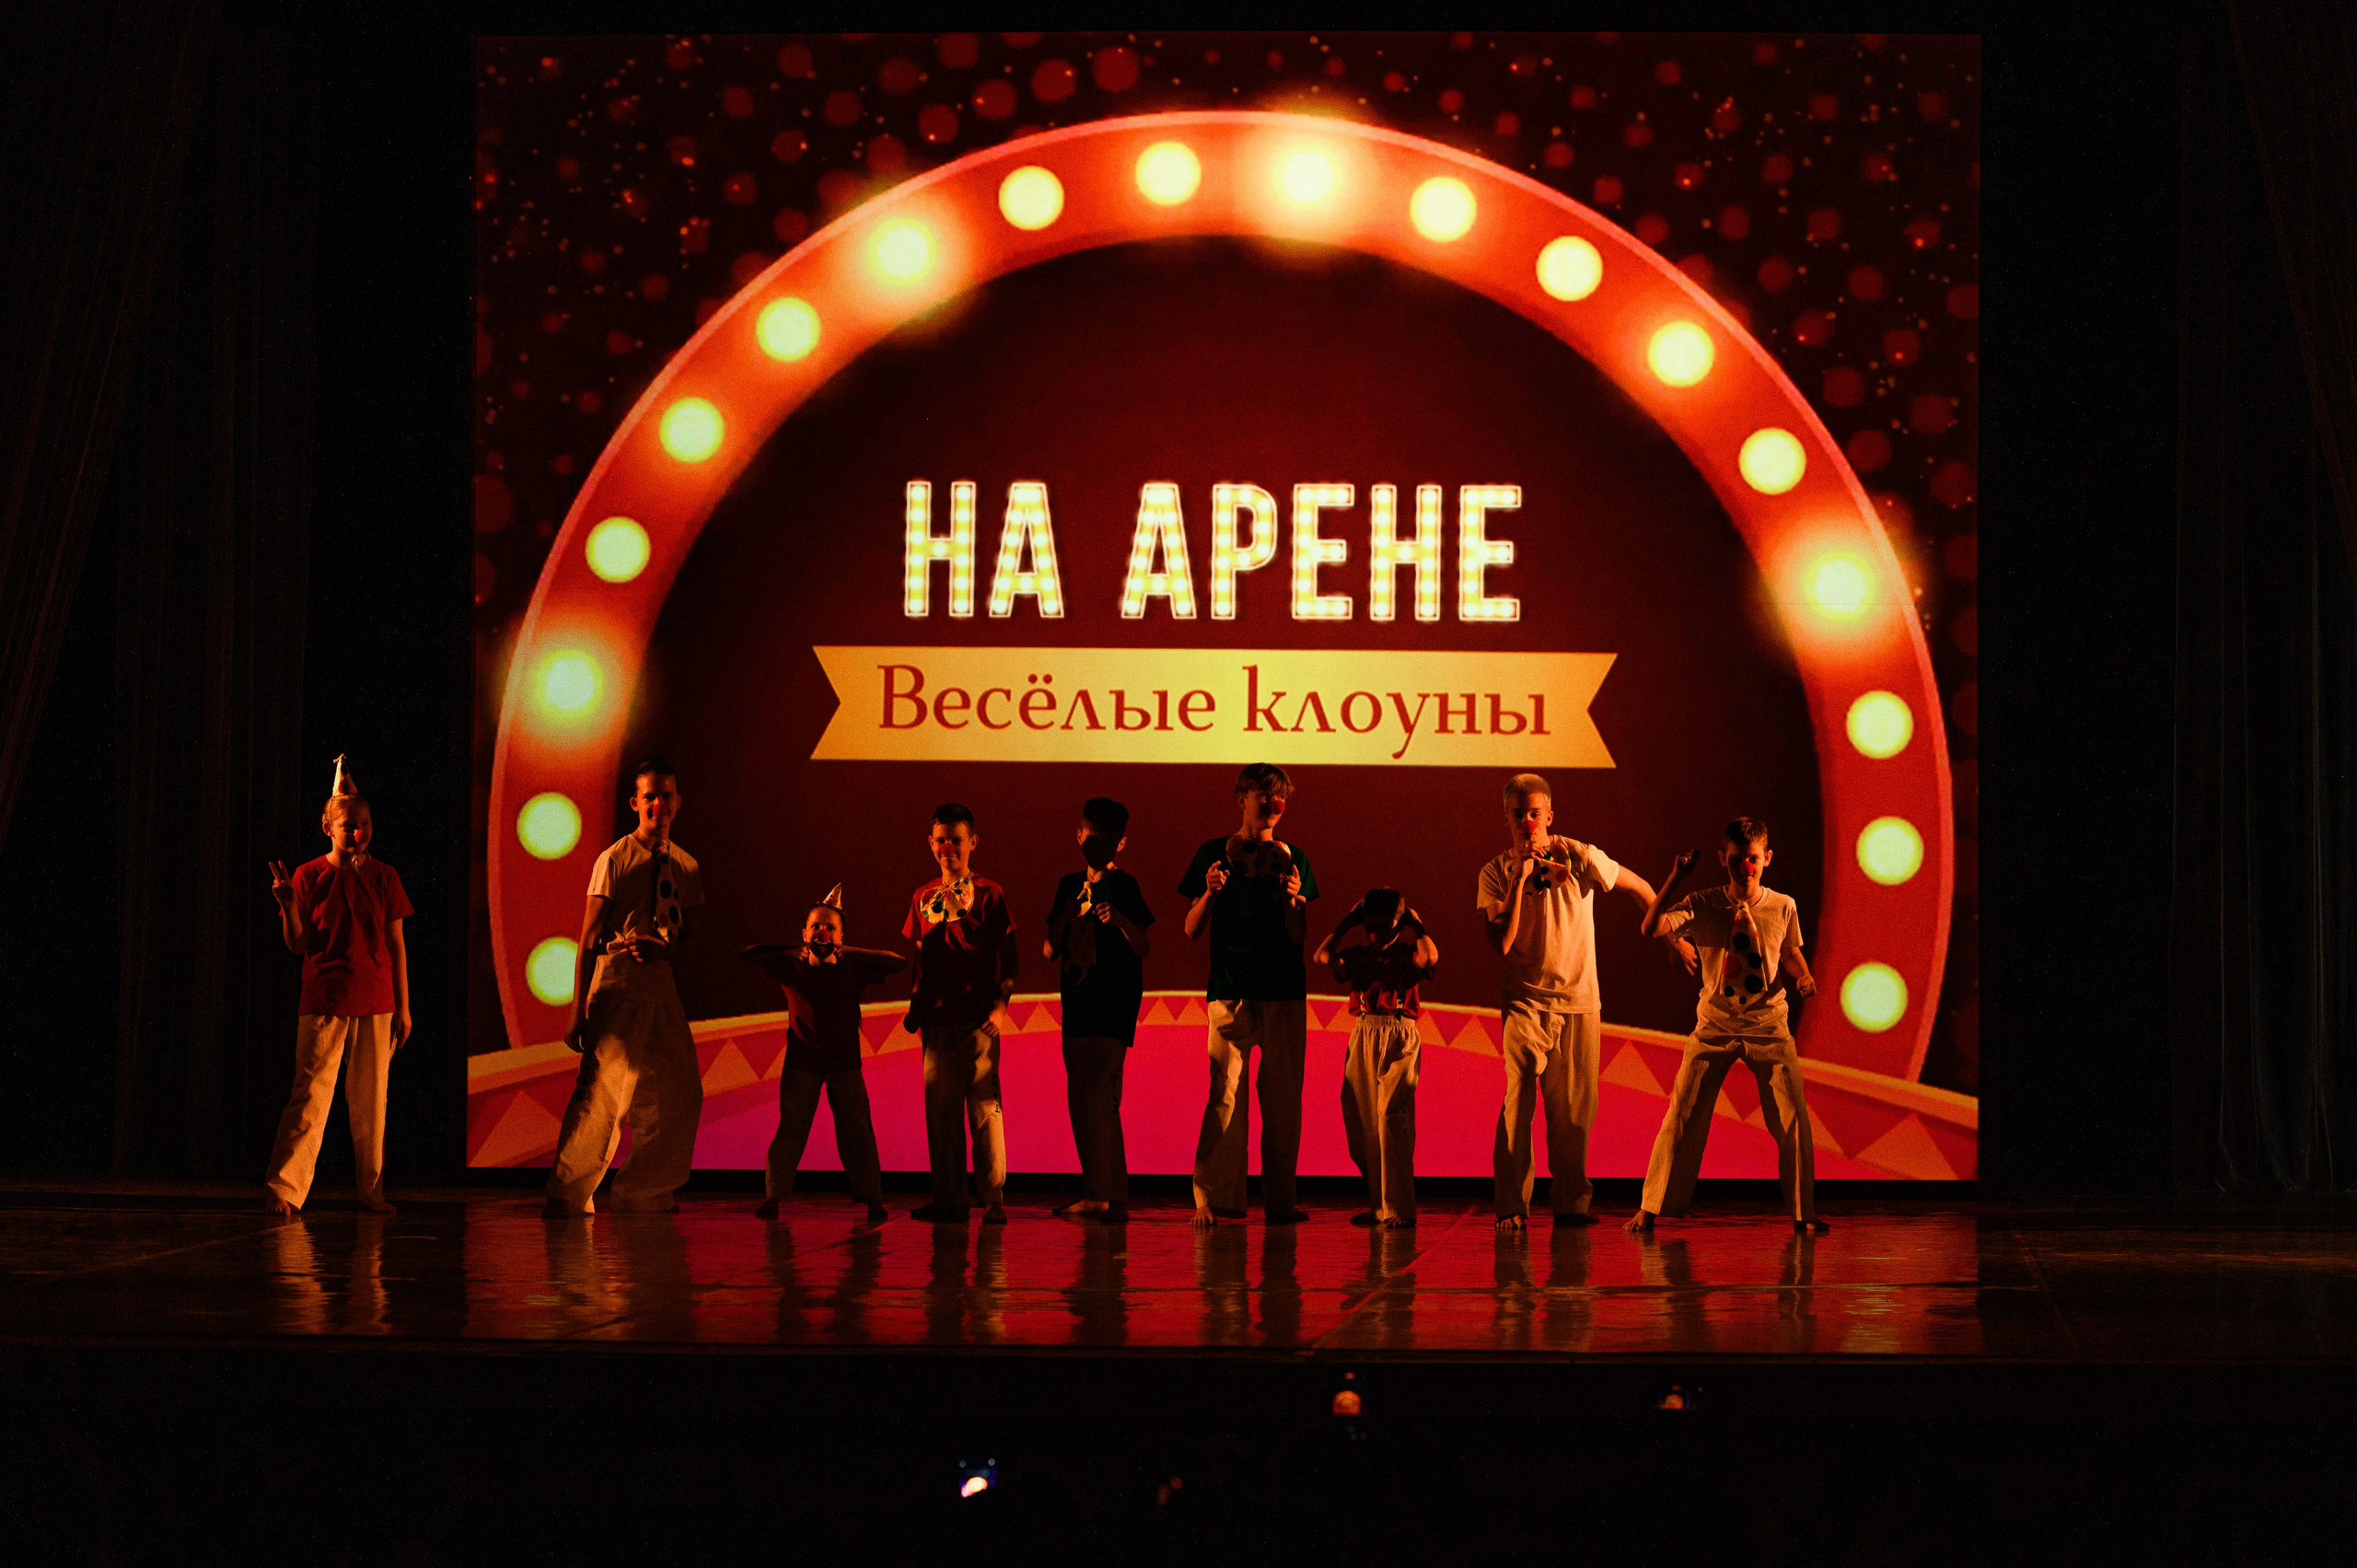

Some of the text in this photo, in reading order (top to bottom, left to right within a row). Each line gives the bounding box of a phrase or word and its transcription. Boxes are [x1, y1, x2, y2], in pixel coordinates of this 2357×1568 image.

[904, 481, 1522, 621] НА АРЕНЕ
[877, 664, 1551, 760] Весёлые клоуны
